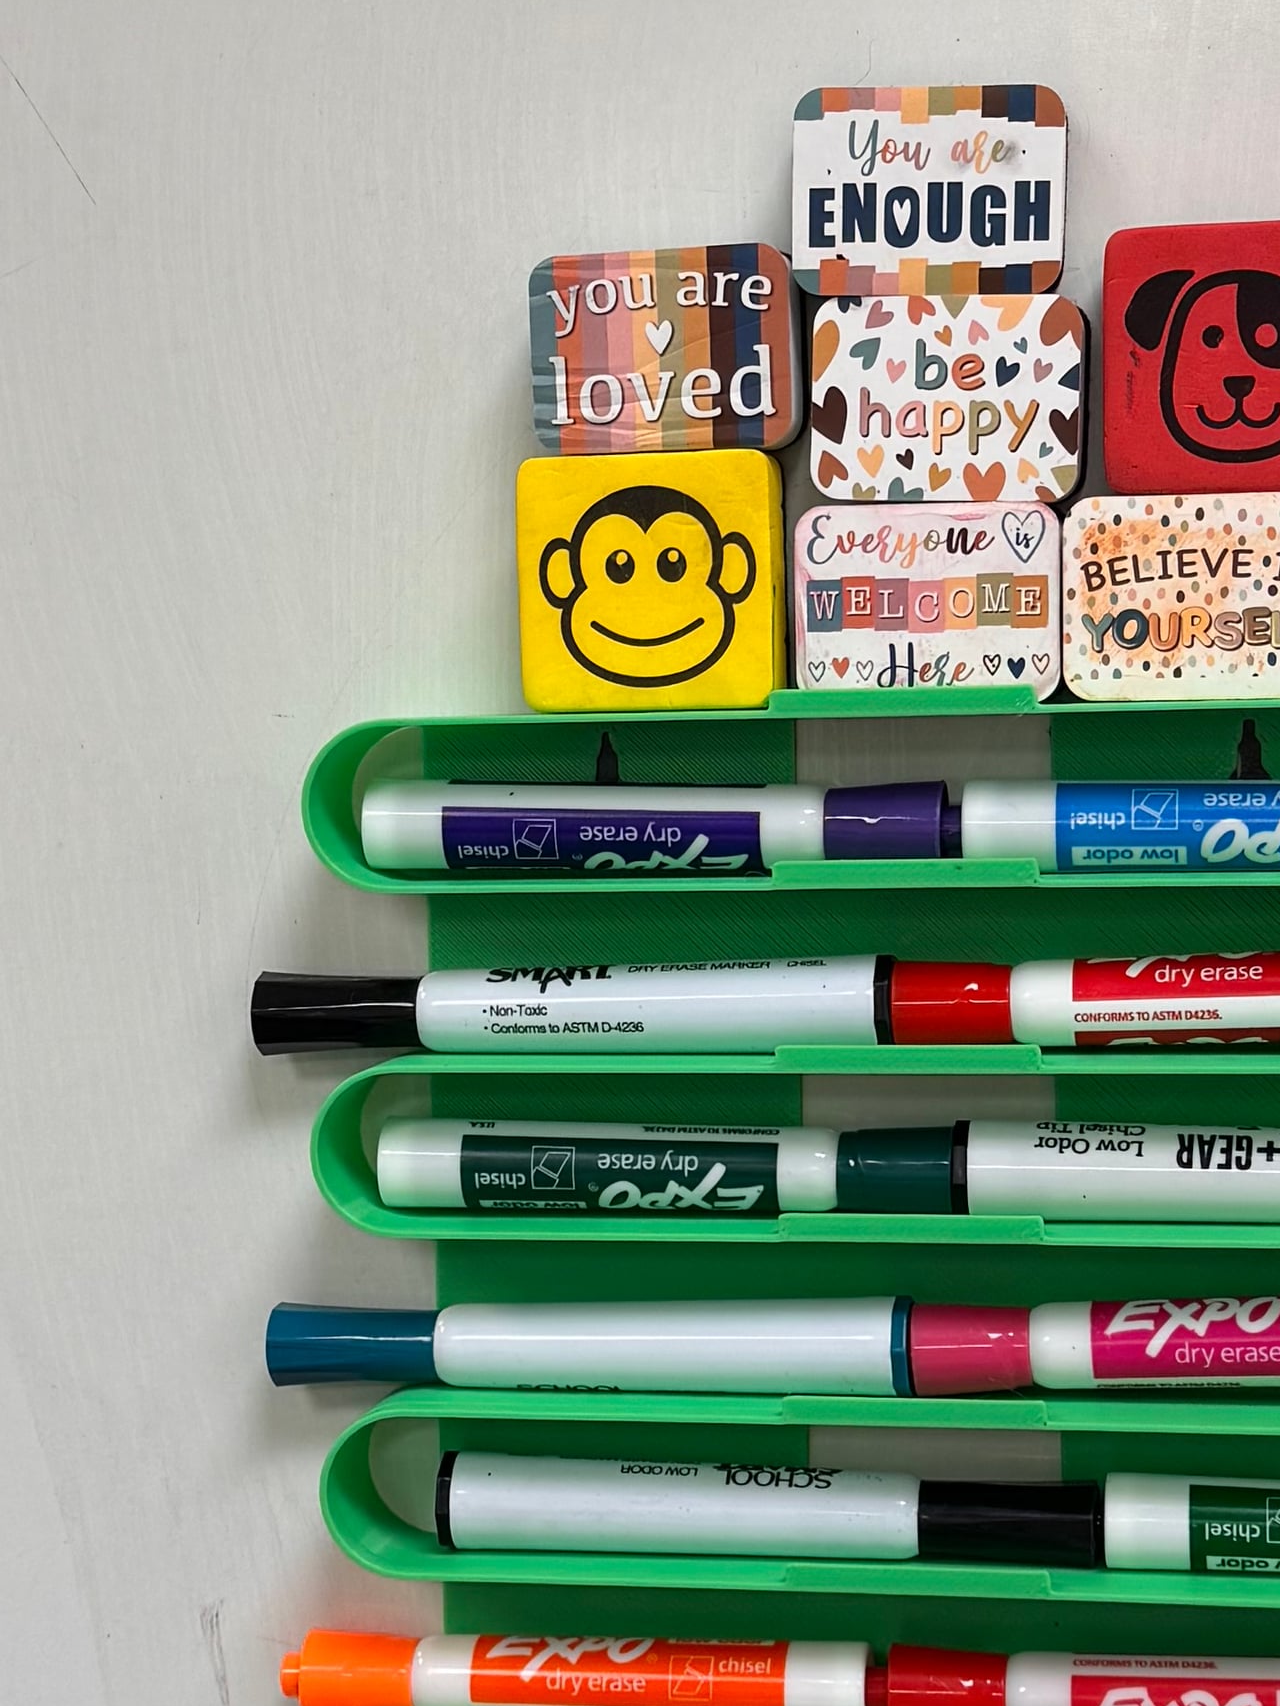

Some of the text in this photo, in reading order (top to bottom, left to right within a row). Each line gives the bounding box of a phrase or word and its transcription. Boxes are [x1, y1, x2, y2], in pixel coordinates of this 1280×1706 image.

[847, 118, 1010, 178] You are
[808, 179, 1051, 248] ENOUGH
[548, 268, 773, 338] you are
[914, 340, 984, 392] be
[552, 346, 777, 426] loved
[859, 387, 1040, 456] happy
[808, 506, 1034, 569] Everyone is
[1080, 549, 1253, 593] BELIEVE
[809, 583, 1043, 622] WELCOME
[878, 643, 975, 690] Here
[1203, 792, 1265, 806] erase
[1070, 812, 1125, 829] chisel
[580, 826, 682, 848] dry erase
[458, 843, 509, 859] chisel
[1081, 848, 1180, 864] low odor
[1154, 965, 1195, 986] dry
[1200, 962, 1263, 982] erase
[490, 1005, 548, 1017] Non-Toxic
[1074, 1012, 1134, 1023] CONFORMS
[1137, 1011, 1149, 1022] TO
[1151, 1011, 1182, 1022] ASTM
[492, 1022, 644, 1034] Conforms to ASTM D-4236
[1035, 1137, 1144, 1157] Low Odor
[598, 1154, 699, 1177] dry erase
[475, 1173, 526, 1188] chisel
[598, 1163, 765, 1210] EXPO
[1175, 1344, 1215, 1367] dry
[621, 1464, 698, 1476] LOW ODOR
[722, 1469, 832, 1489] SCHOOL
[1204, 1523, 1260, 1539] chisel
[1216, 1557, 1270, 1570] odor
[718, 1658, 771, 1674] chisel
[545, 1671, 646, 1695] dry erase
